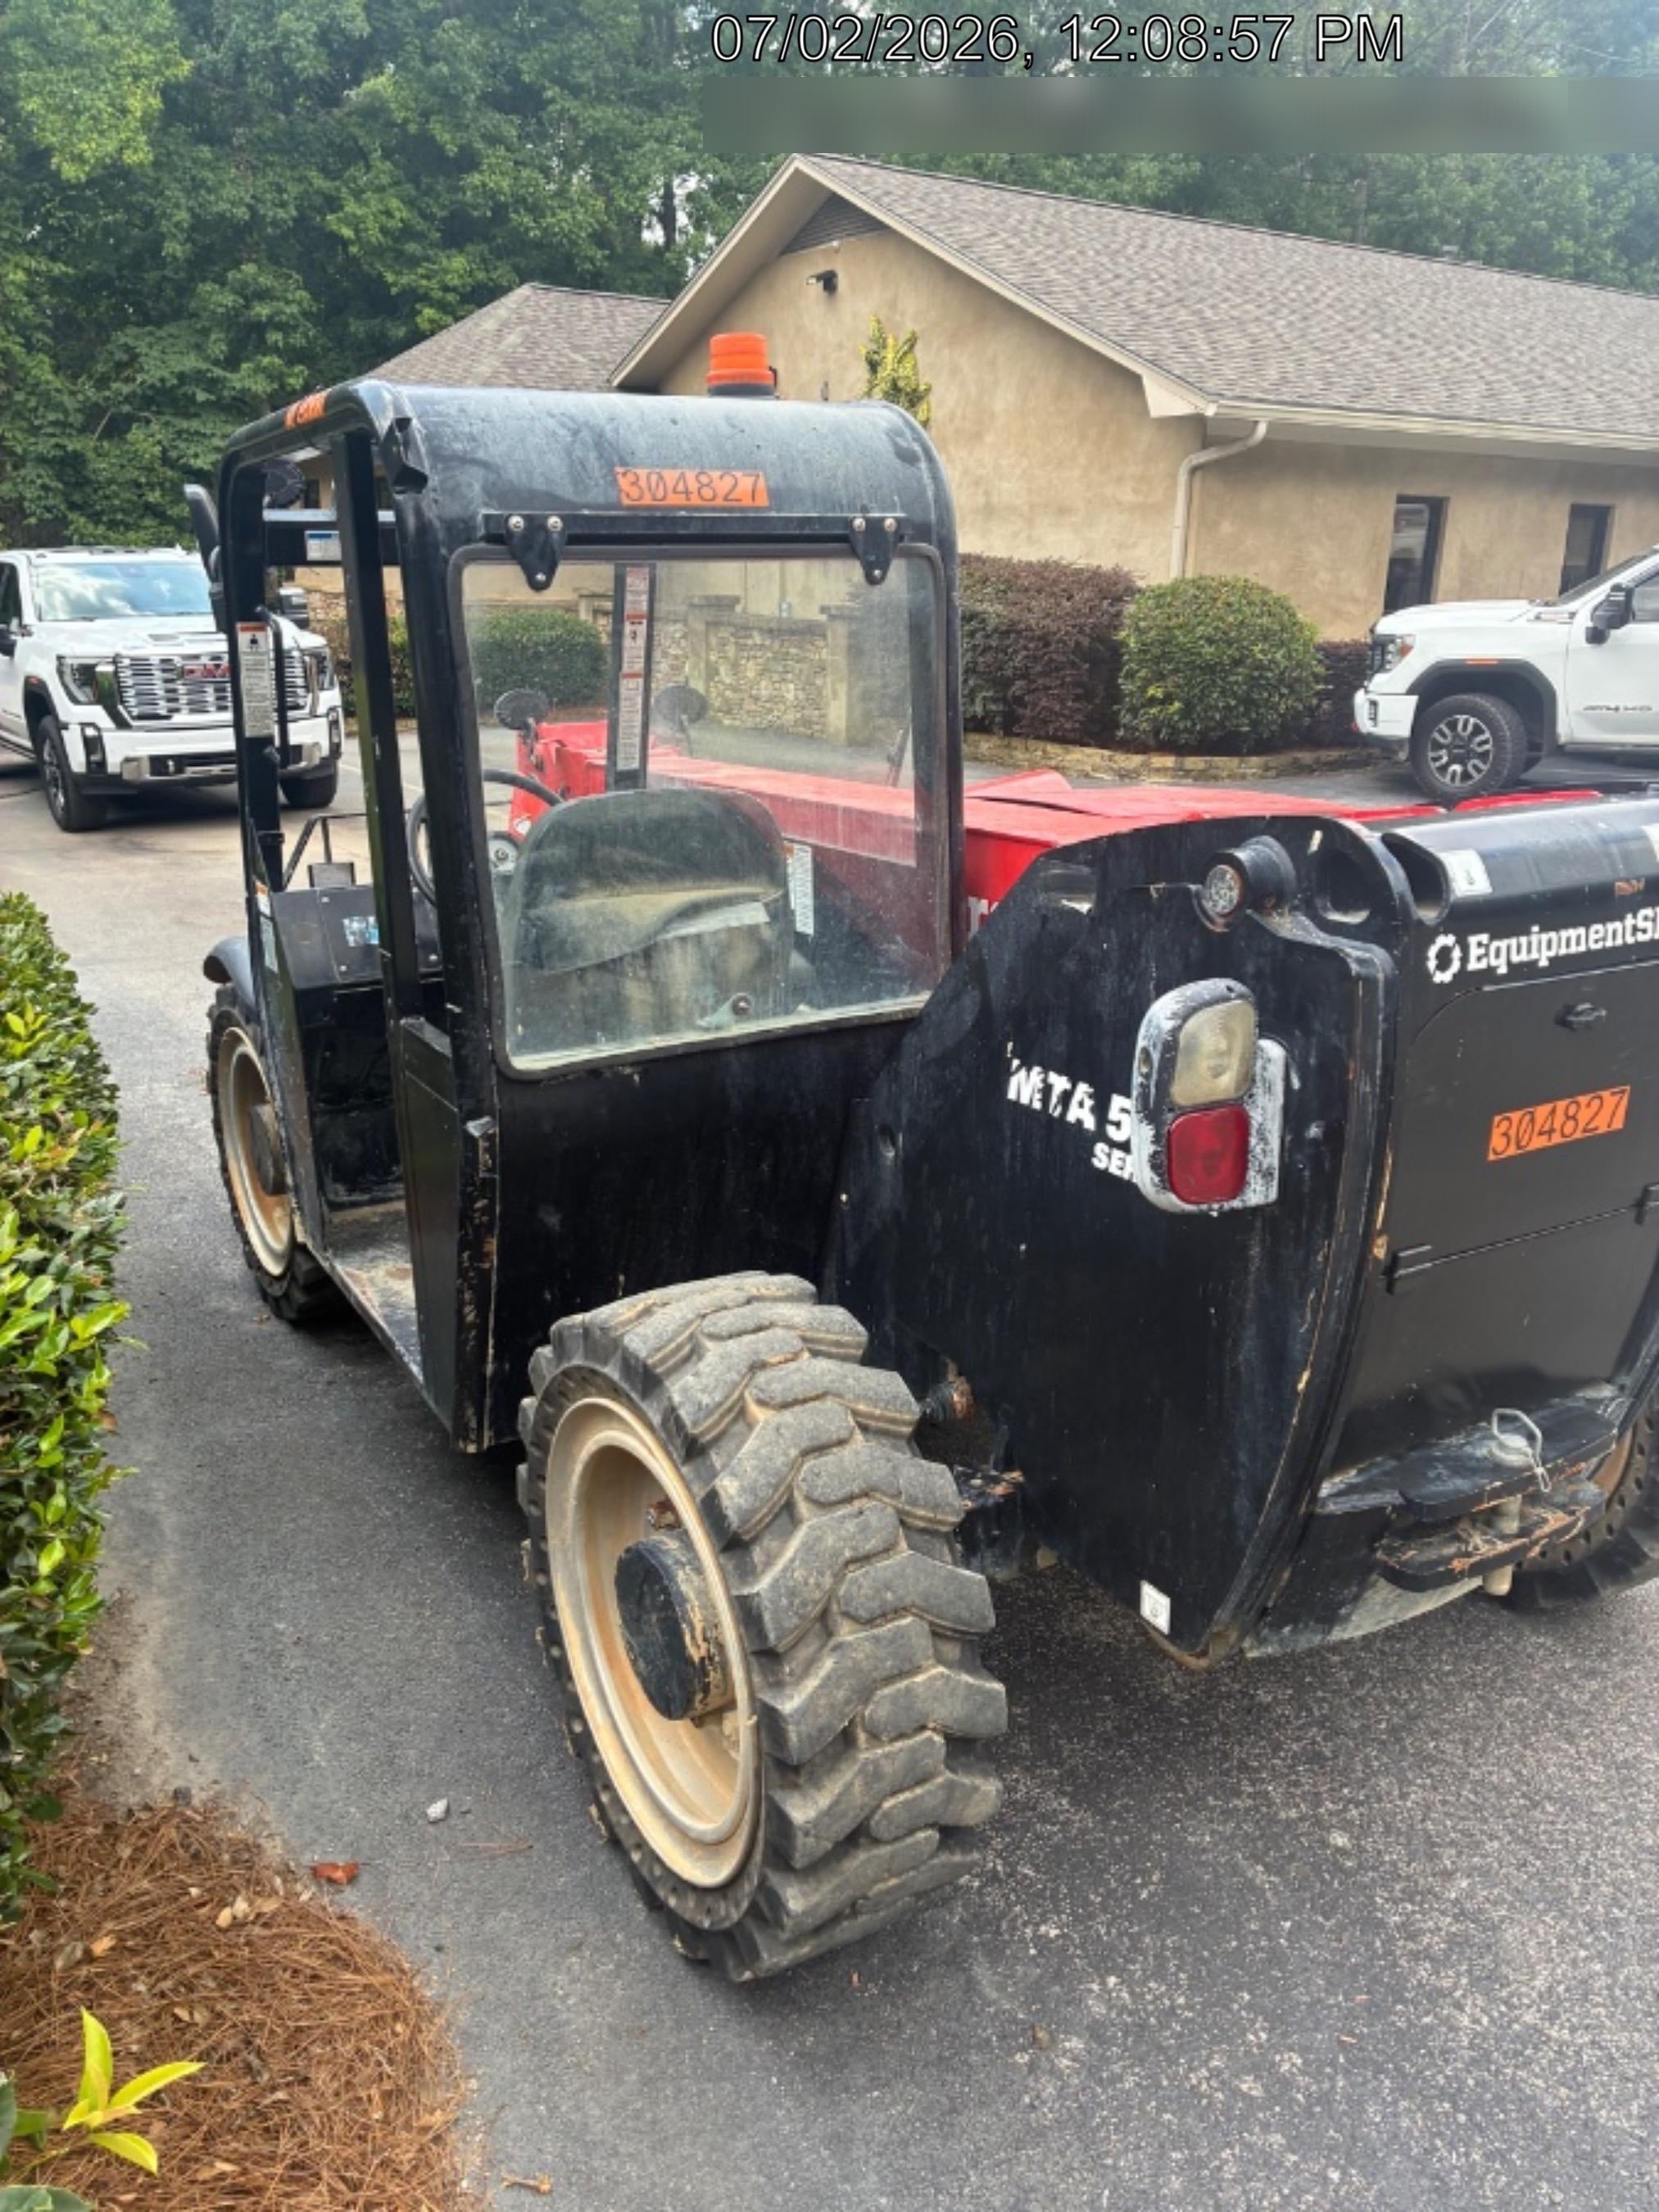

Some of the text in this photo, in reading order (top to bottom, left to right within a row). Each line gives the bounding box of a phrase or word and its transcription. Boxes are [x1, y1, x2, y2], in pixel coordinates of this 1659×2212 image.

[617, 469, 762, 504] 304827
[1466, 906, 1659, 975] EquipmentS
[1491, 1088, 1630, 1156] 304827
